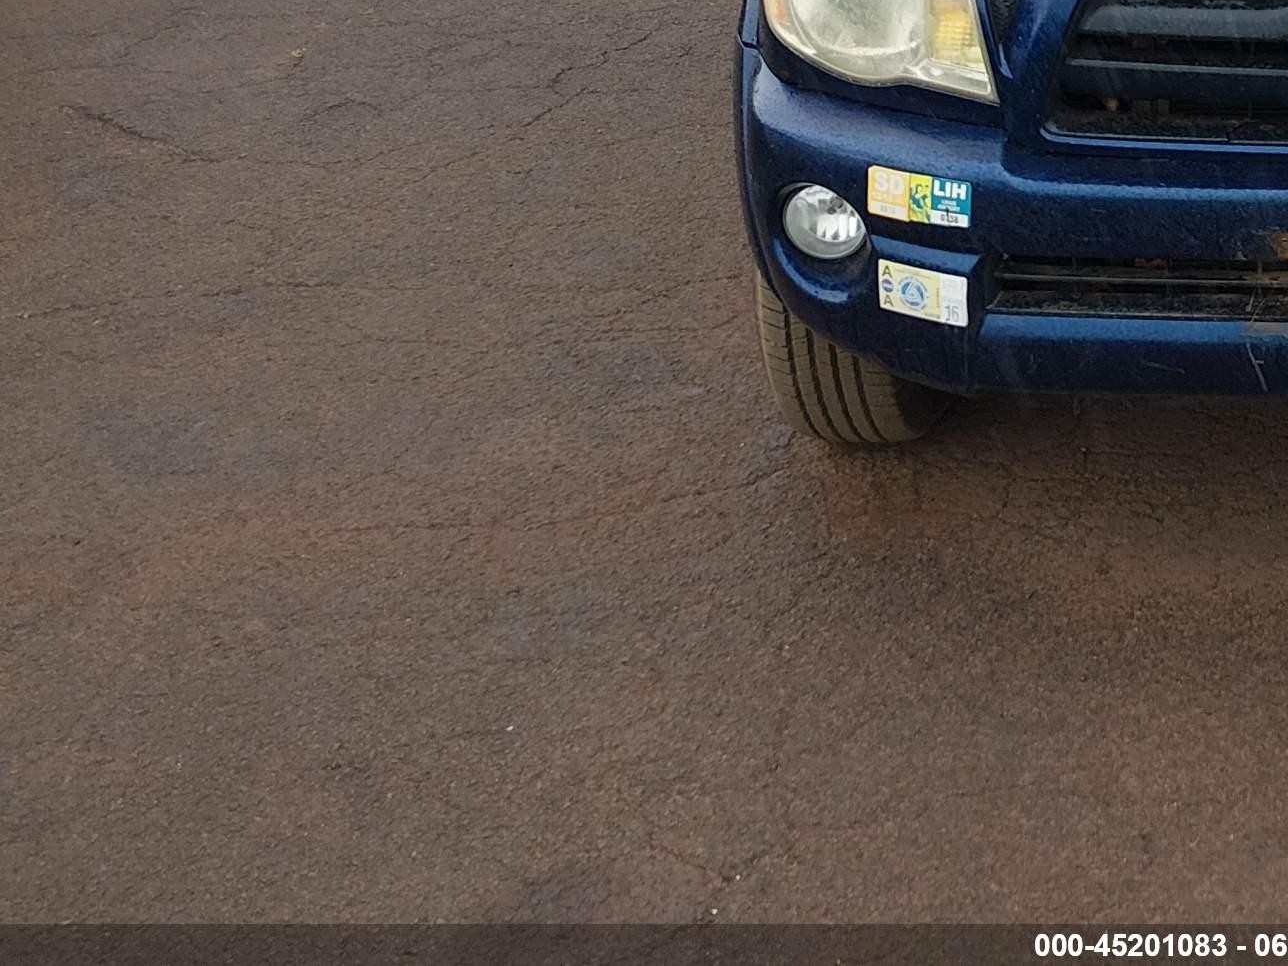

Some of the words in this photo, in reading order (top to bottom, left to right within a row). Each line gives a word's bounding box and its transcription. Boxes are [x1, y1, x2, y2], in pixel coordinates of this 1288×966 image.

[933, 179, 967, 201] LIH
[881, 265, 893, 279] A
[883, 294, 894, 307] A
